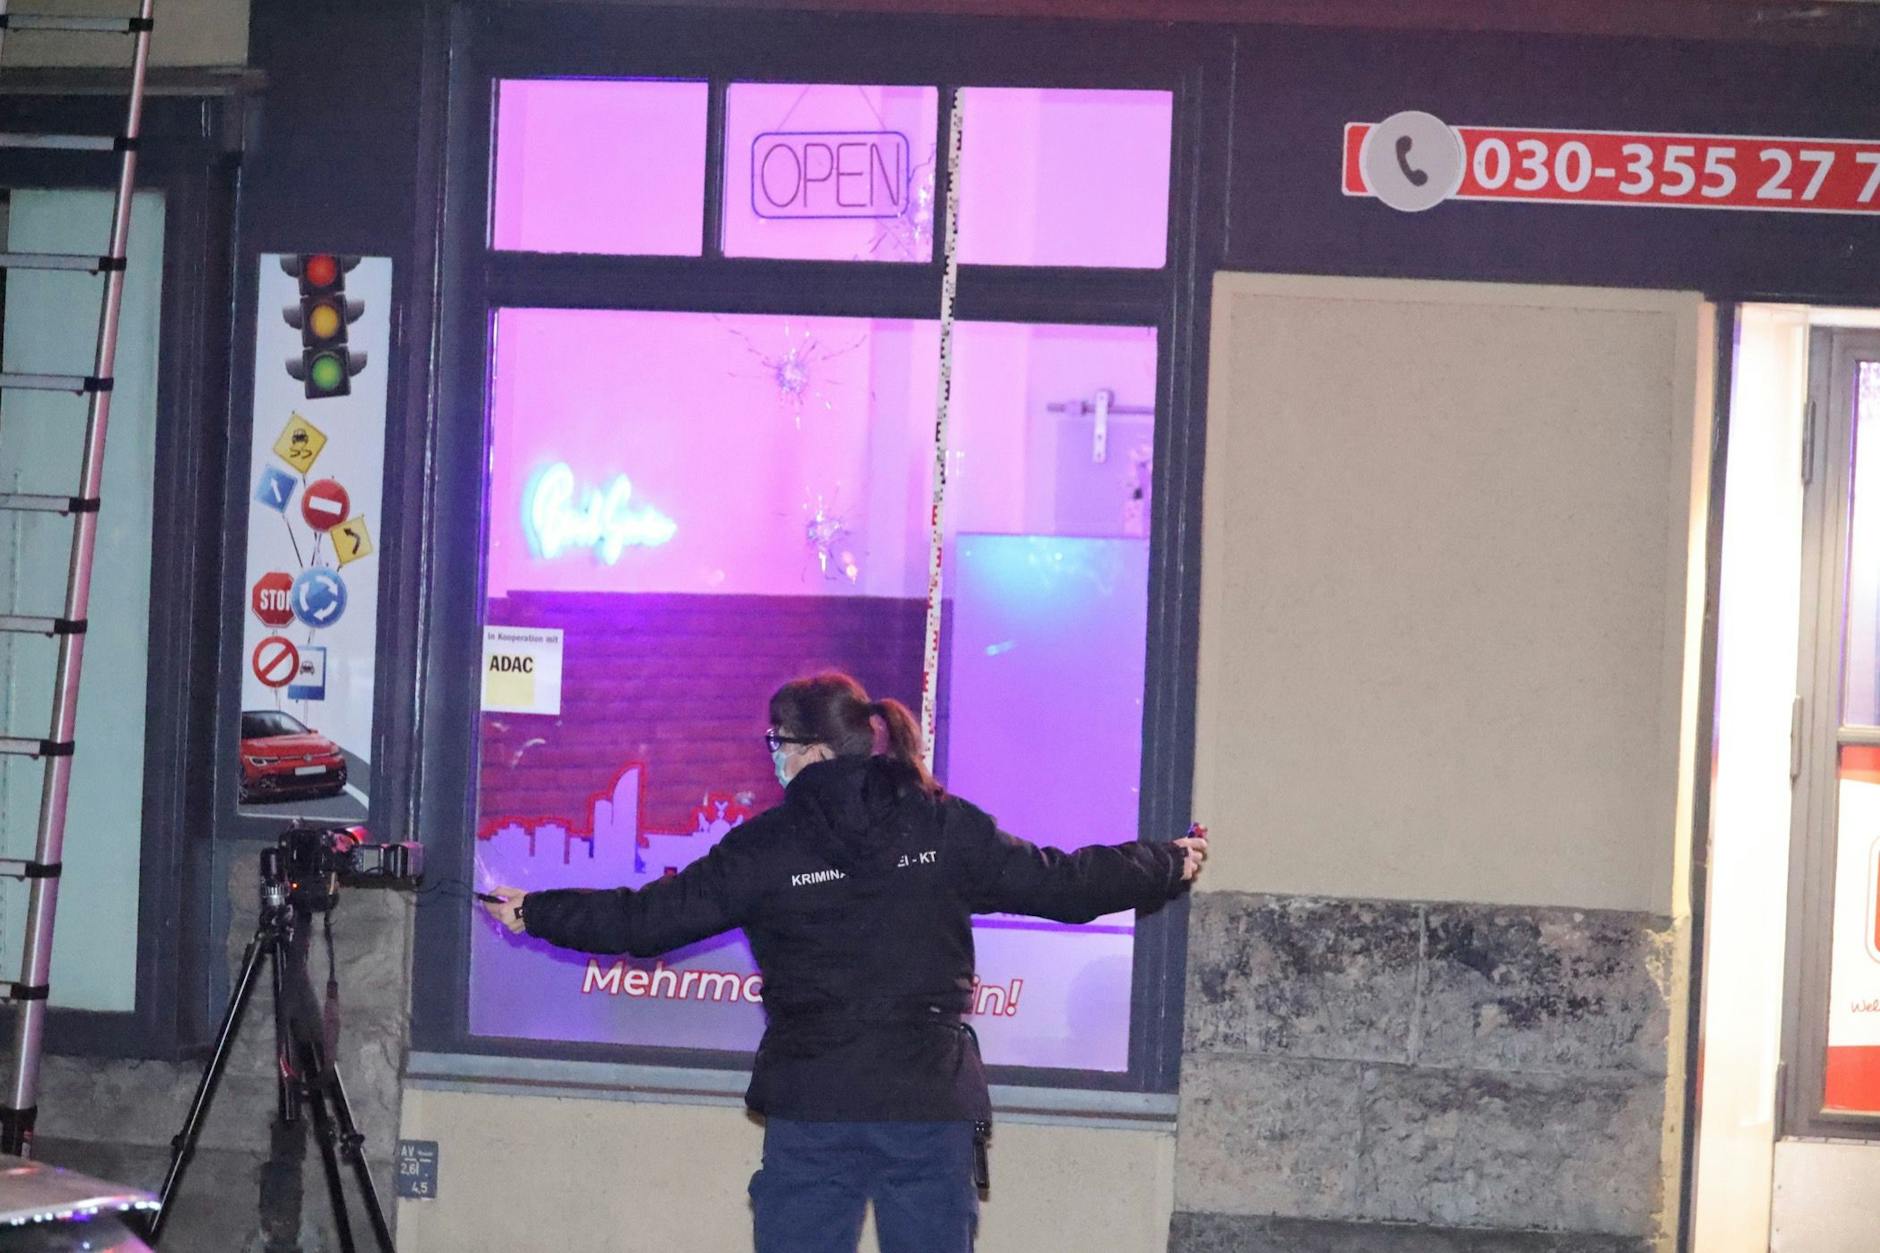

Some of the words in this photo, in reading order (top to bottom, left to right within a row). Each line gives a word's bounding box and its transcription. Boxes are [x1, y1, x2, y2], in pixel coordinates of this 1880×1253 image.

[760, 142, 900, 208] OPEN
[1473, 138, 1737, 198] 030-355
[1756, 148, 1835, 200] 27
[489, 655, 534, 674] ADAC
[919, 850, 937, 865] KT
